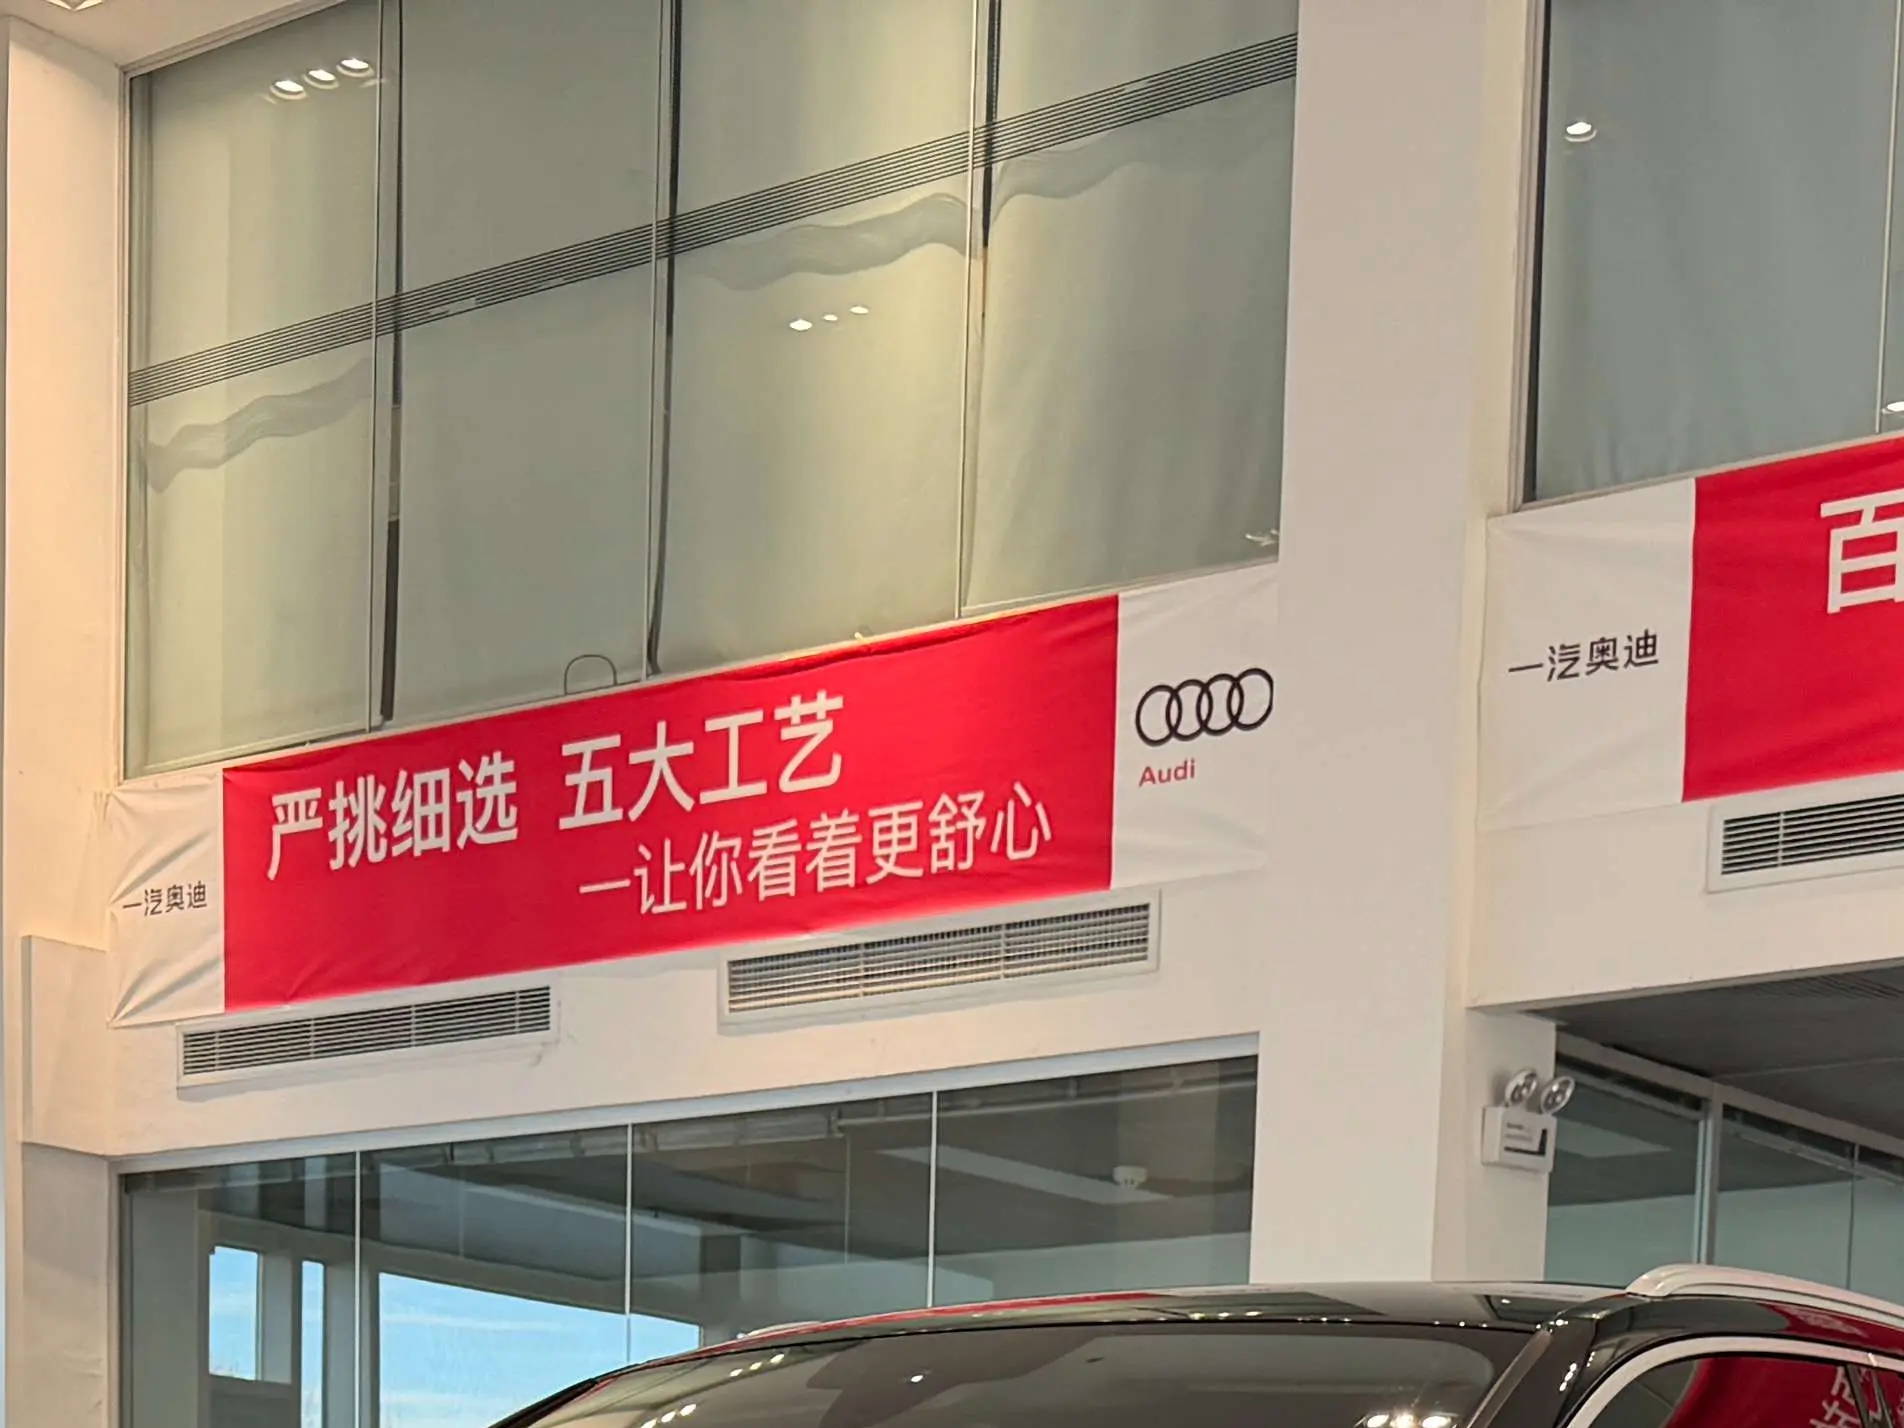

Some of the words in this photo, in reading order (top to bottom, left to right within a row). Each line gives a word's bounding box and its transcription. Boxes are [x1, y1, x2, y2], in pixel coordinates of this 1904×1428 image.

[1508, 628, 1659, 682] 一汽奥迪
[267, 751, 518, 880] 严挑细选
[559, 690, 843, 829] 五大工艺
[1139, 757, 1195, 787] Audi
[122, 881, 207, 917] 一汽奥迪
